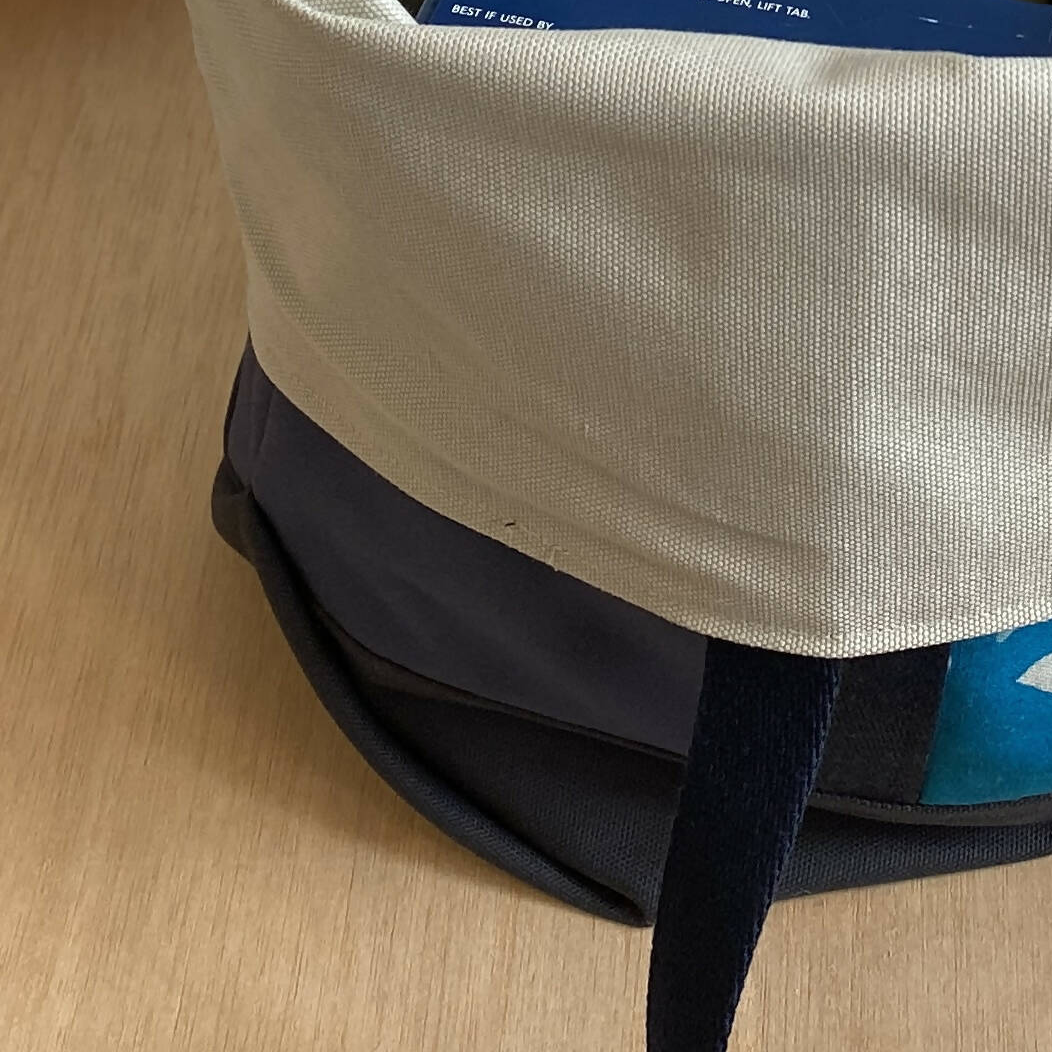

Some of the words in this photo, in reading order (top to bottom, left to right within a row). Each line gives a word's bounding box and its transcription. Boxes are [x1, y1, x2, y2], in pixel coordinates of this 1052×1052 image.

[451, 3, 483, 18] BEST
[484, 10, 498, 20] IF
[500, 13, 534, 27] USED
[536, 20, 555, 30] BY
[757, 0, 782, 13] LIFT
[786, 5, 811, 19] TAB.
